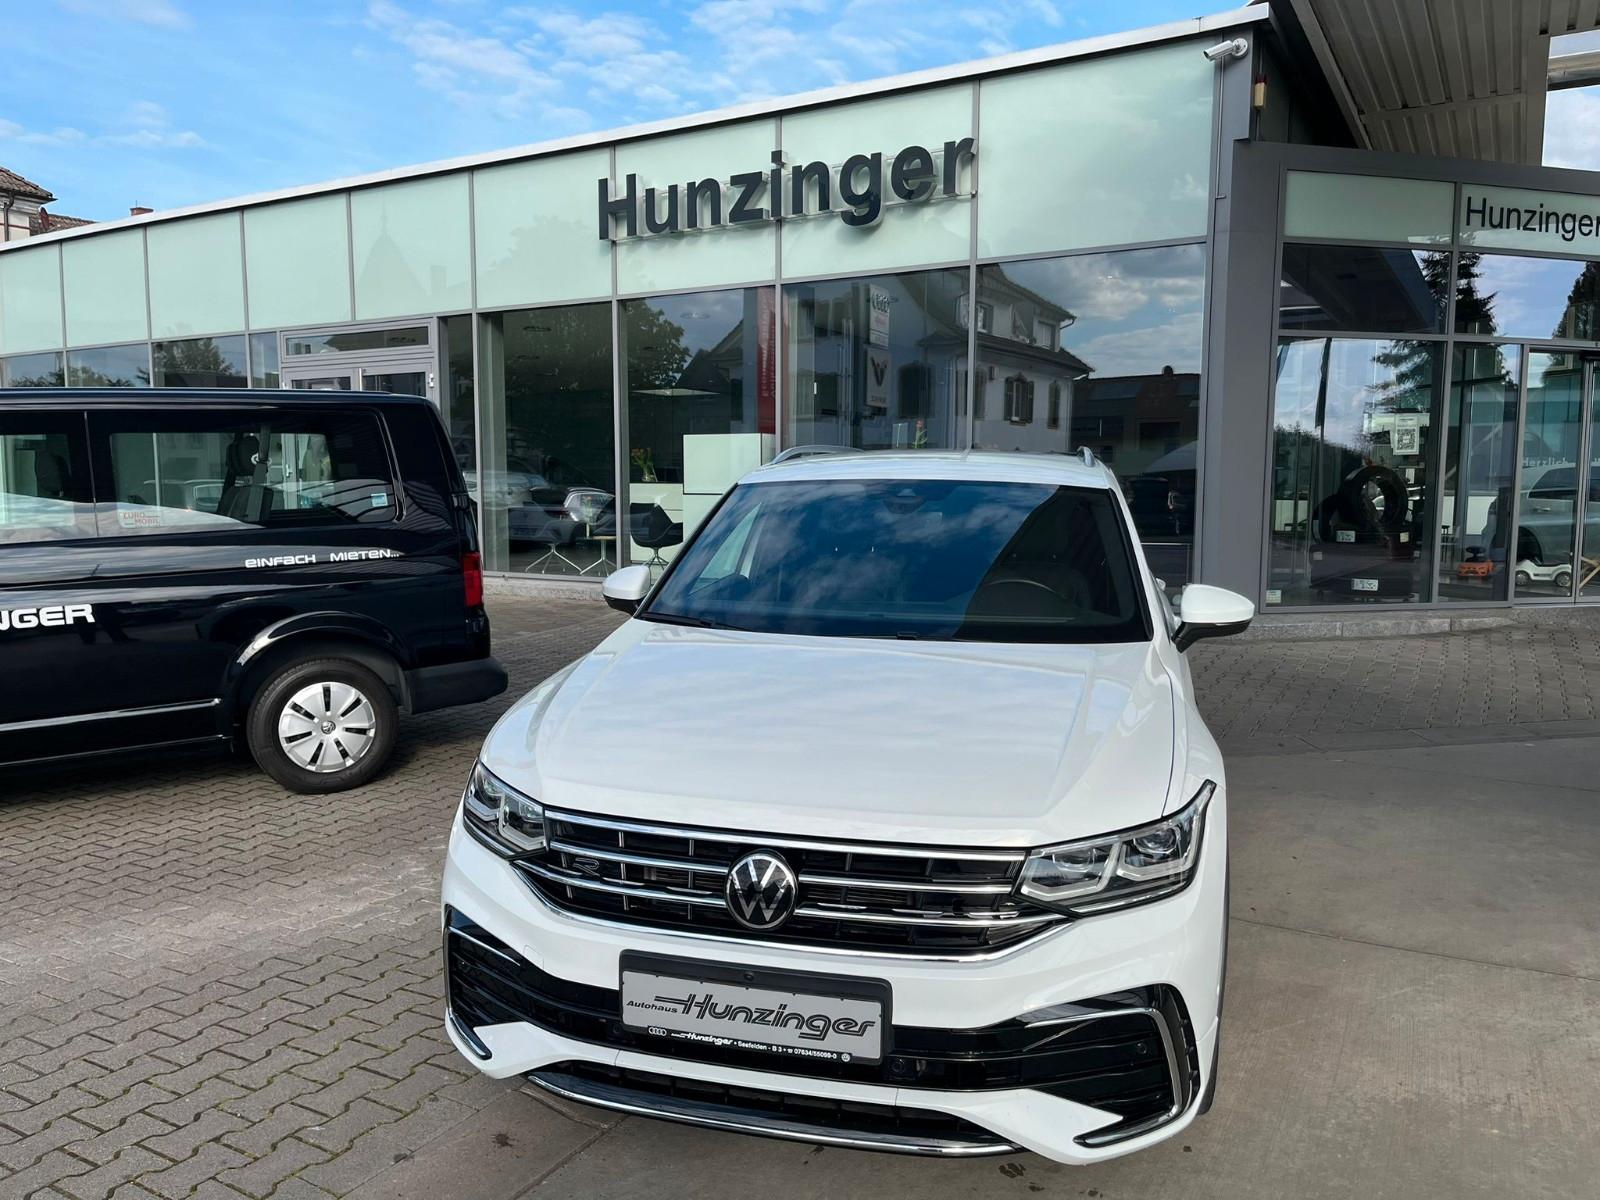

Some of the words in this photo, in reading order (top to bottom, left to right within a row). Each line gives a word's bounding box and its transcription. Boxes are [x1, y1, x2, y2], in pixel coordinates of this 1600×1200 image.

[598, 137, 975, 241] Hunzinger
[626, 1000, 678, 1014] Autohaus
[654, 993, 876, 1041] Hunzinger
